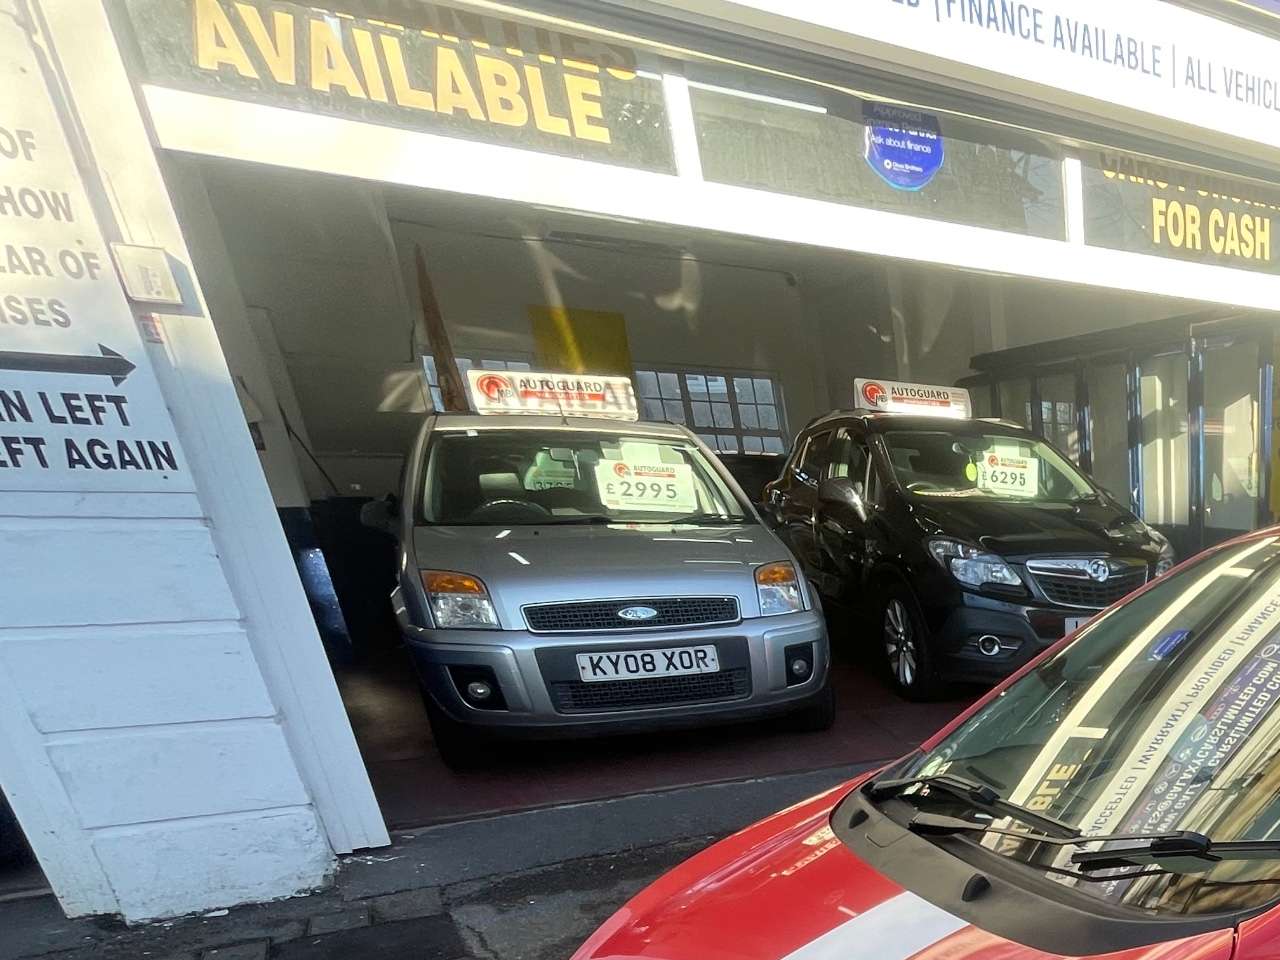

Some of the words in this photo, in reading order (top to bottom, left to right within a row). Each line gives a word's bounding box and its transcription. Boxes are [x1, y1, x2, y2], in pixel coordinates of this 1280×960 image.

[947, 0, 1045, 44] FINANCE
[1053, 15, 1162, 78] AVAILABLE
[1185, 55, 1217, 94] ALL
[194, 0, 611, 144] AVAILABLE
[0, 126, 37, 161] OF
[1152, 197, 1203, 251] FOR
[1208, 207, 1272, 262] CASH
[0, 243, 53, 278] AR
[59, 246, 102, 281] OF
[519, 378, 603, 392] AUTOGUARD
[891, 386, 950, 400] AUTOGUARD
[38, 391, 130, 427] LEFT
[0, 436, 49, 469] FT
[65, 437, 178, 472] AGAIN
[589, 651, 656, 678] KY08
[666, 646, 709, 672] XOR
